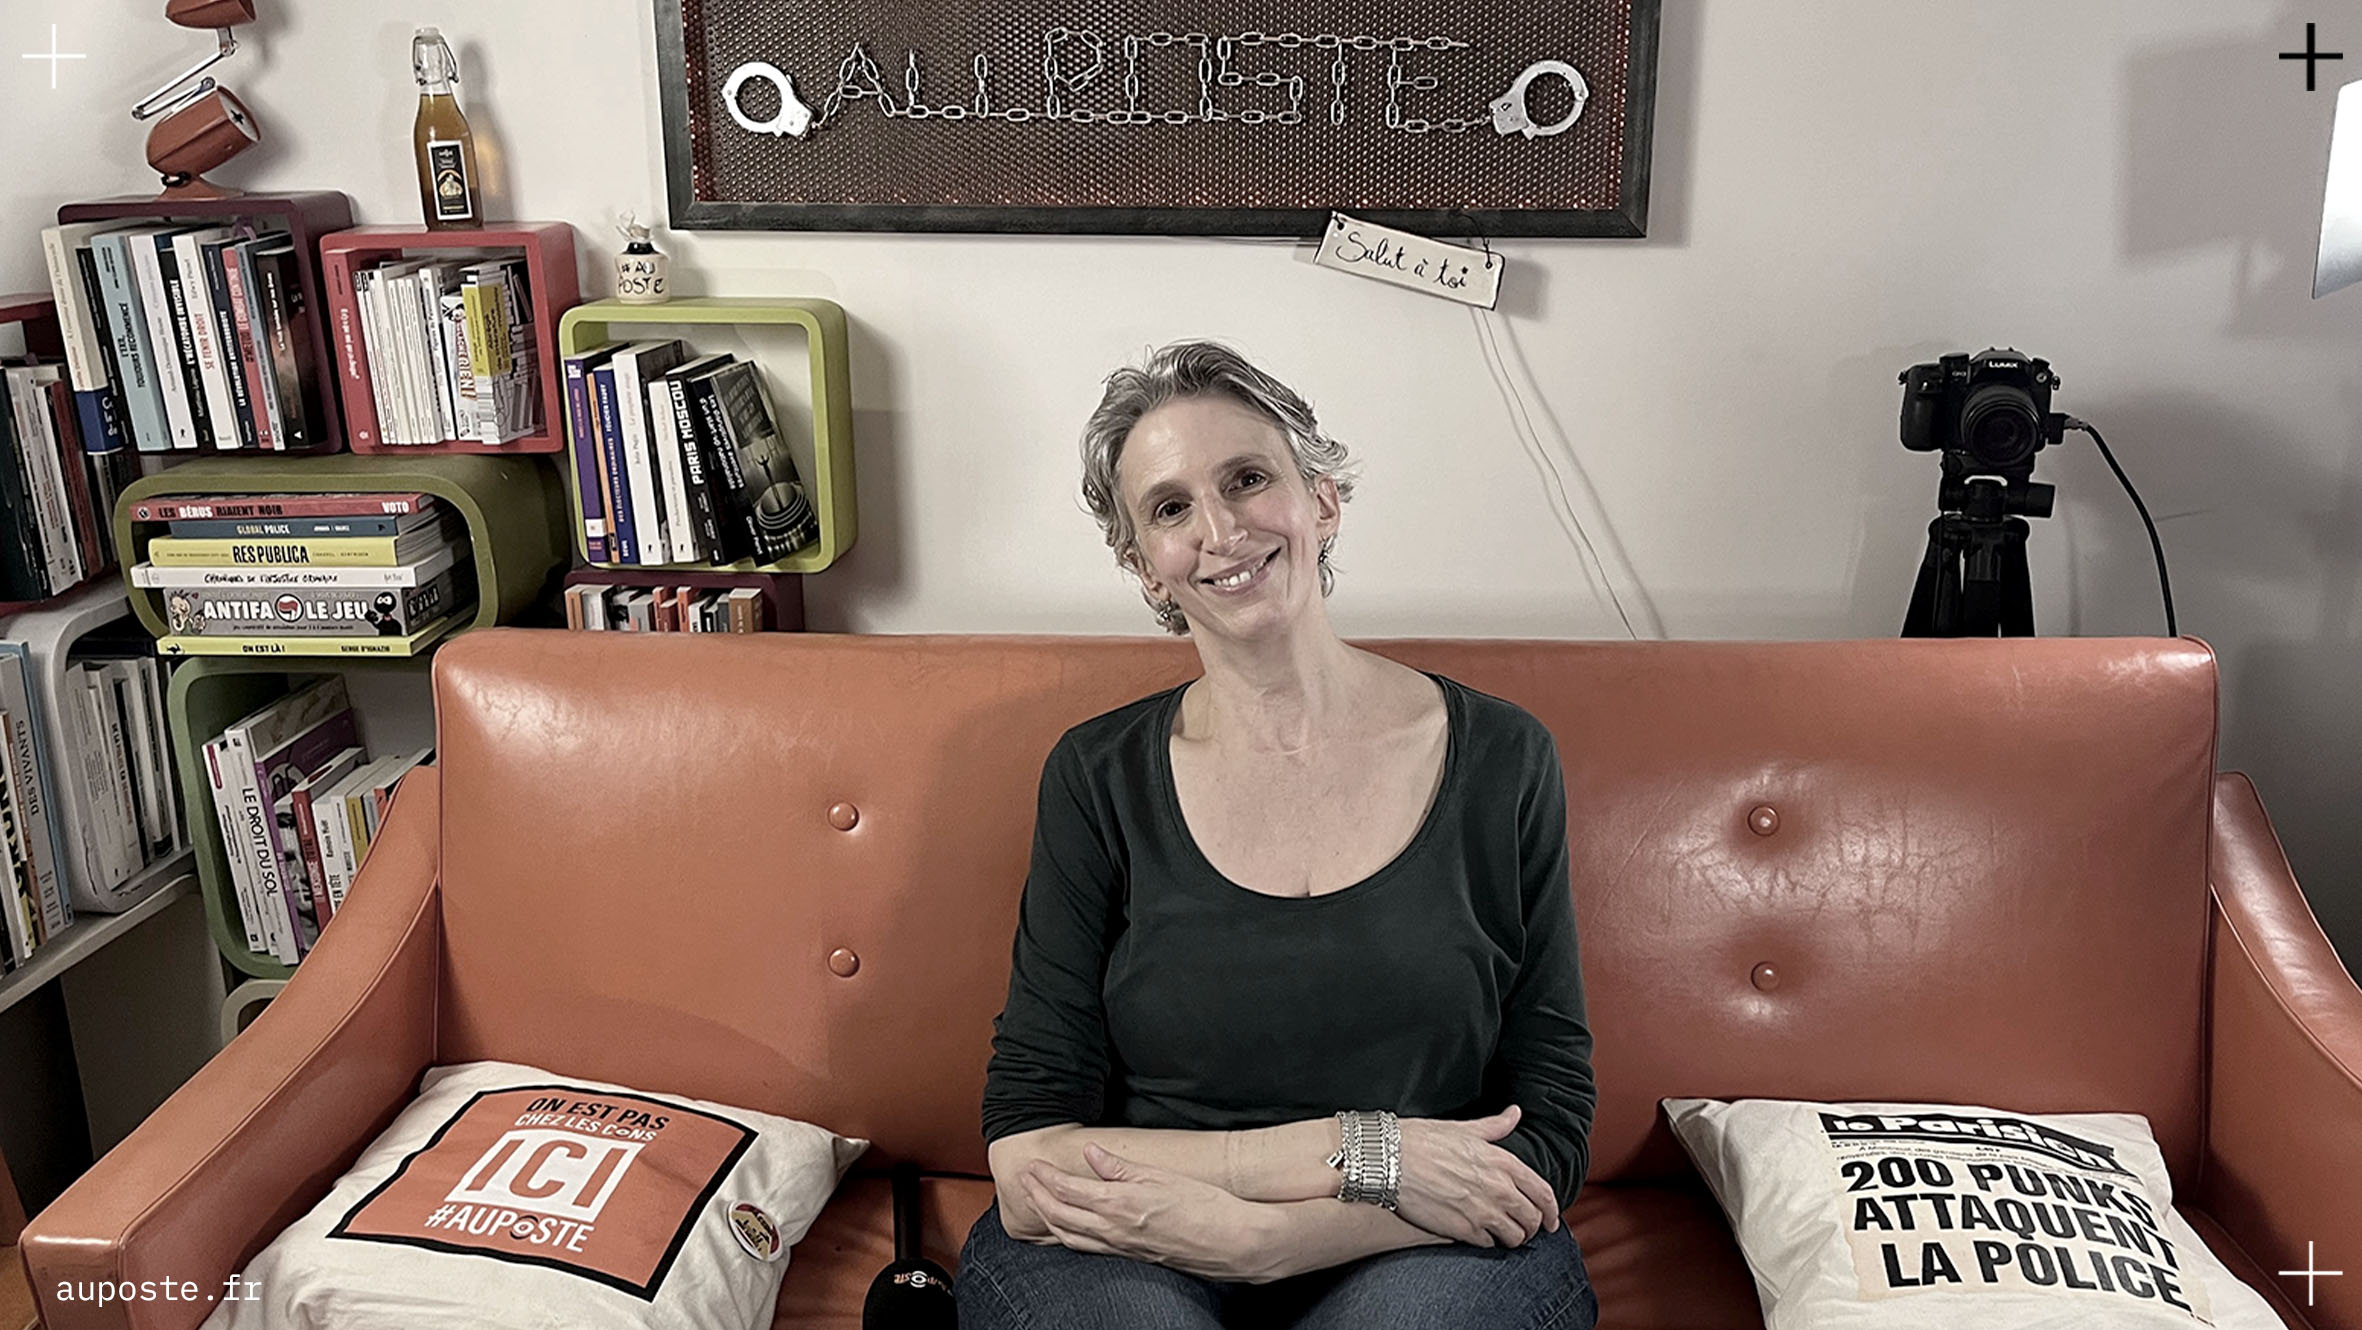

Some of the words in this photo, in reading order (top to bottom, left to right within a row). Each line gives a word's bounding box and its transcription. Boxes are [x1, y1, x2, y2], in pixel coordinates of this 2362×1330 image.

[1336, 231, 1407, 271] Salut
[1414, 258, 1428, 277] à
[1434, 259, 1468, 289] toi
[169, 279, 186, 316] INVISIBLE
[195, 311, 208, 336] DROIT
[199, 336, 212, 359] TENIR
[130, 352, 148, 388] TOUJOURS
[204, 359, 214, 370] SE
[669, 379, 694, 440] MOSCOU
[707, 394, 718, 409] Les
[683, 440, 705, 486] PARIS
[159, 508, 176, 519] LES
[258, 504, 283, 516] NOIR
[381, 501, 410, 514] VOTO
[264, 524, 290, 535] POLICE
[232, 546, 256, 563] RES
[257, 546, 310, 563] PUBLICA
[203, 600, 275, 620] ANTIFA
[304, 600, 330, 620] LE
[332, 600, 368, 621] JEU
[242, 645, 254, 653] ON
[255, 644, 269, 653] EST
[271, 643, 281, 652] LÀ
[15, 719, 33, 786] VIVANTS
[25, 786, 40, 816] DES
[241, 786, 256, 803] LE
[245, 804, 269, 849] DROIT
[256, 847, 273, 870] DU
[261, 870, 280, 898] SOL
[327, 873, 343, 890] TÊTE
[514, 1113, 566, 1127] CHEZ
[564, 1116, 601, 1133] LES
[602, 1124, 658, 1142] CONS
[526, 1098, 566, 1113] ON
[567, 1101, 619, 1120] EST
[617, 1109, 670, 1131] PAS
[1833, 1120, 1874, 1131] le
[1878, 1116, 2116, 1170] Parisien
[465, 1138, 628, 1208] ICI
[1841, 1157, 1954, 1193] 200
[1967, 1162, 2160, 1231] PUNKS
[424, 1203, 595, 1253] #AUPOSTE
[1853, 1193, 2180, 1270] ATTAQUENT
[1882, 1241, 1961, 1288] LA
[1974, 1239, 2192, 1312] POLICE
